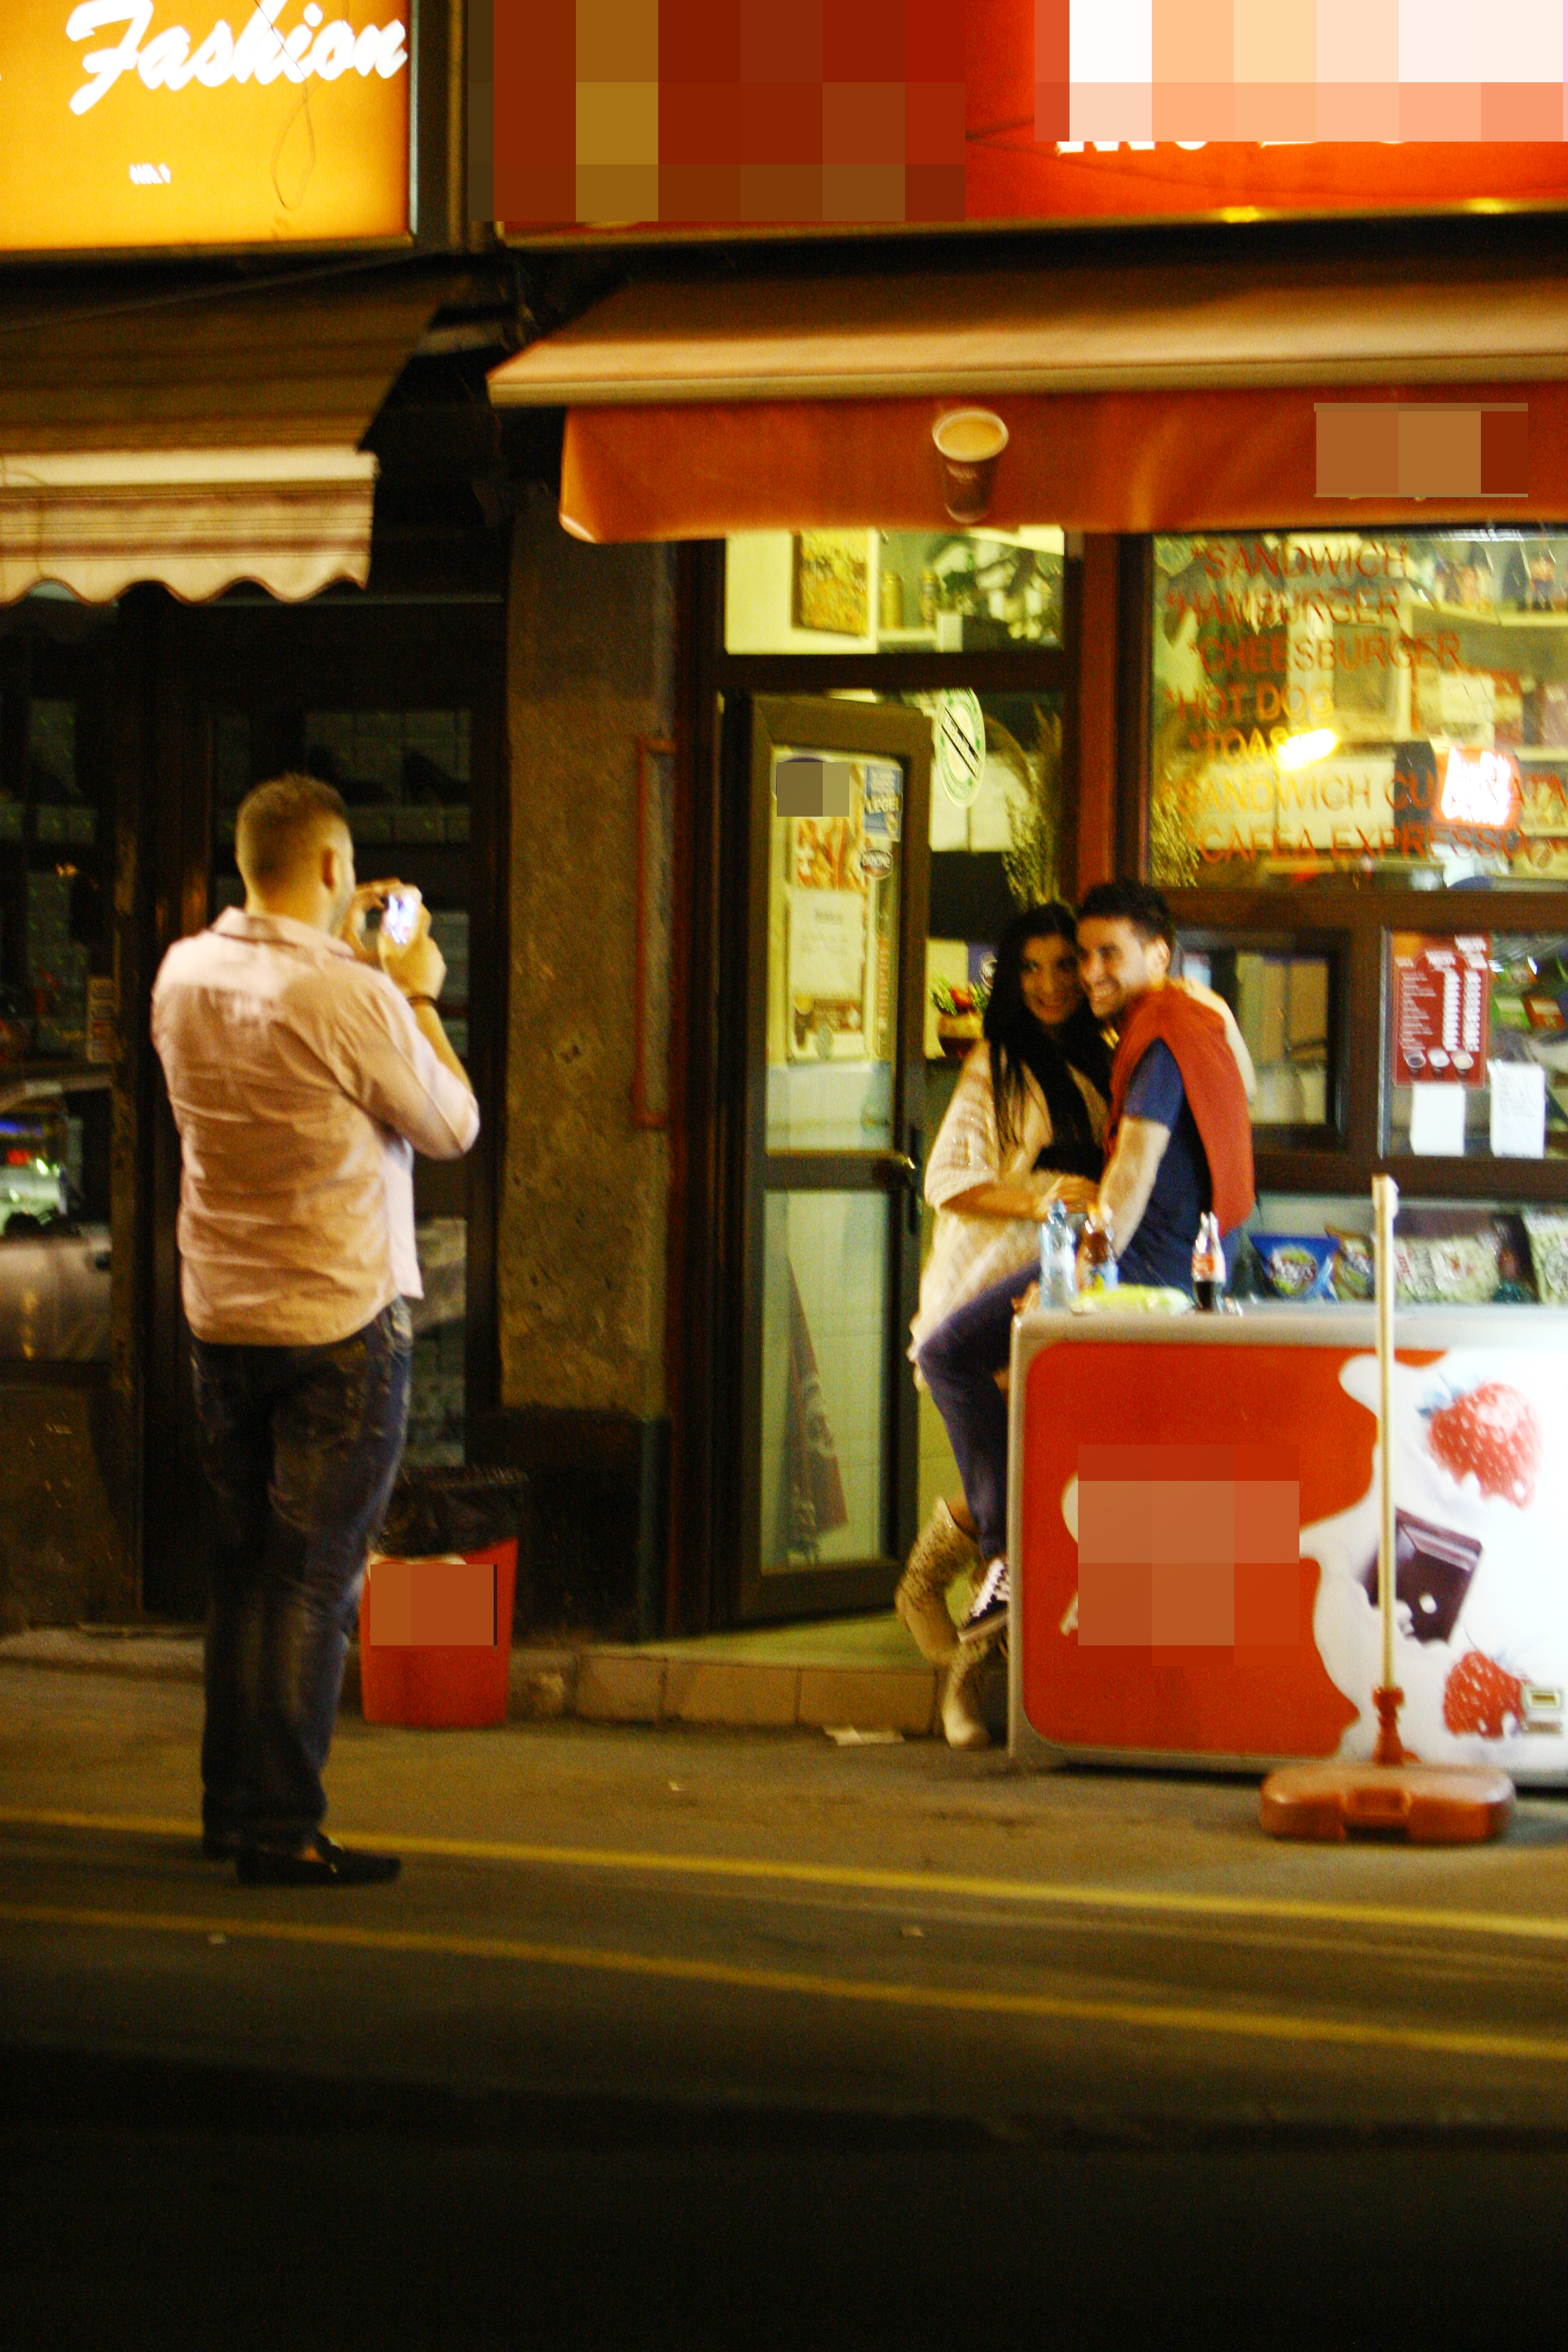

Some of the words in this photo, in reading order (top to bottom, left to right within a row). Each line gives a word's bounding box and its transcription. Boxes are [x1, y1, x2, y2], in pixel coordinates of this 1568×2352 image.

[65, 0, 408, 115] Fashion
[1204, 540, 1408, 578] SANDWICH
[1177, 587, 1400, 627] HAMBURGER
[1255, 682, 1334, 721] DOG
